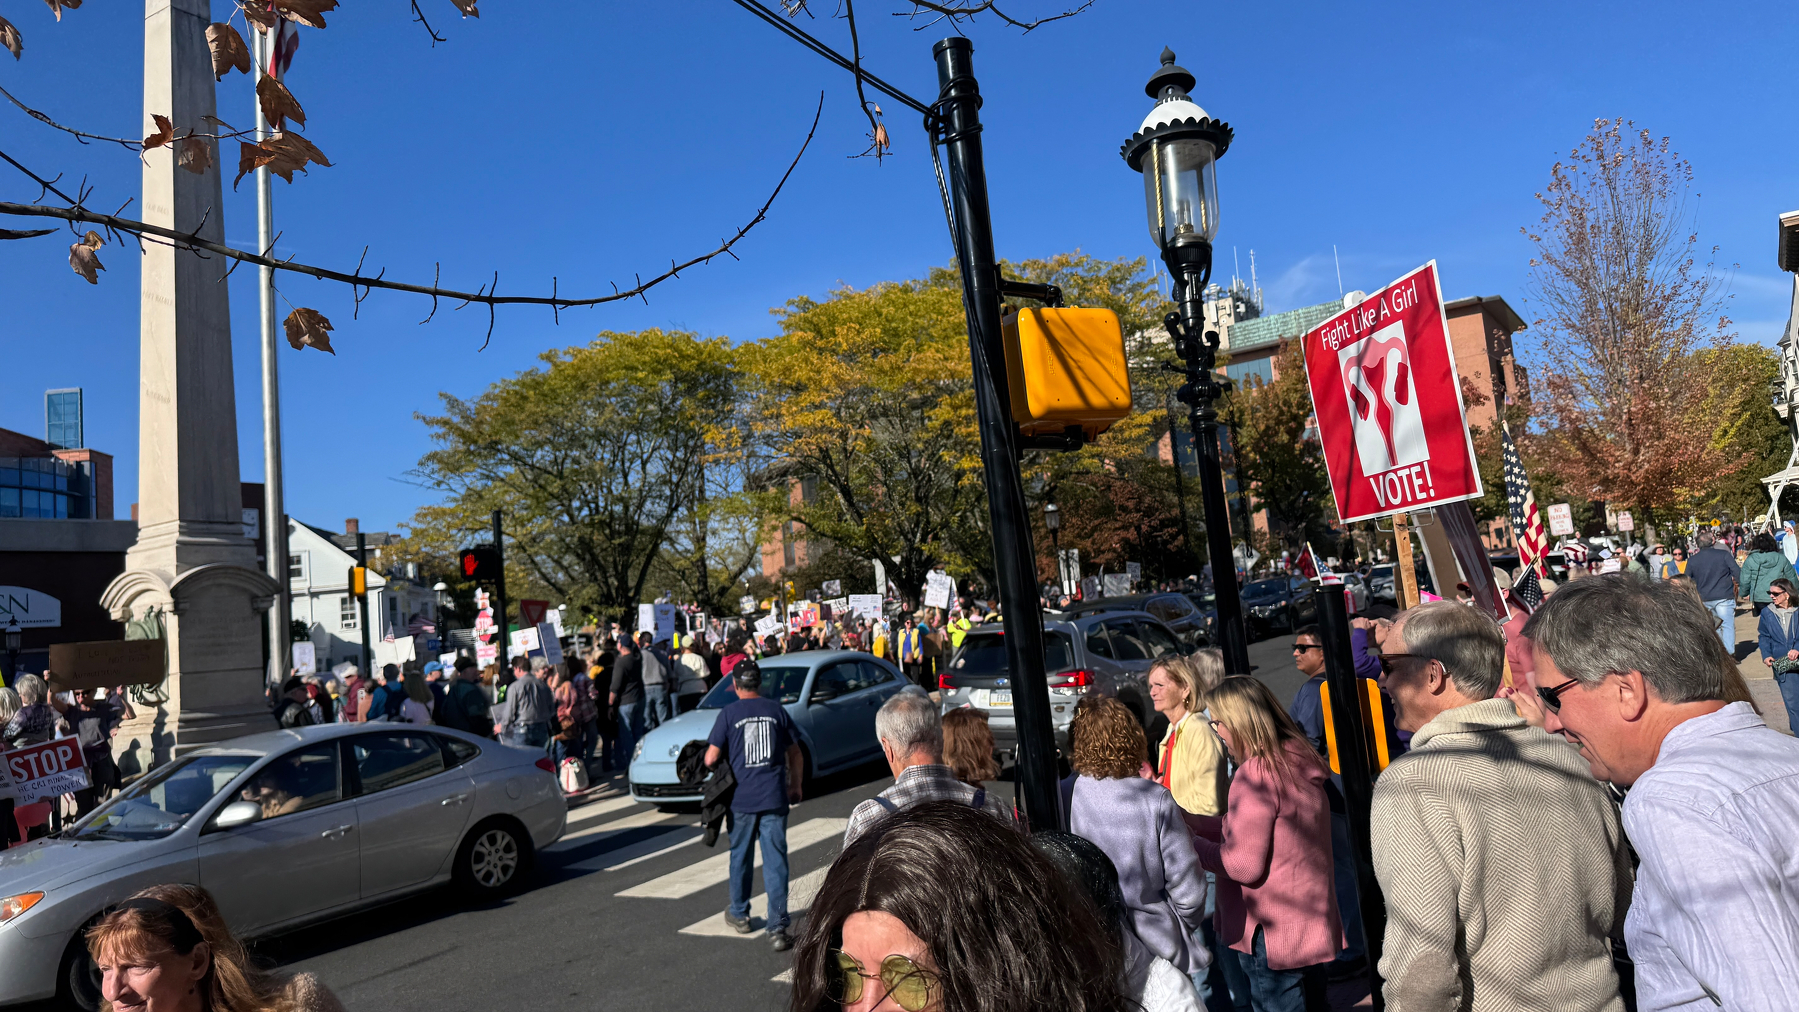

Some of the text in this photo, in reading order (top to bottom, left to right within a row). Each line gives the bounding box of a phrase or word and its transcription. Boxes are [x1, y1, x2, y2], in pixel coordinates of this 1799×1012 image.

[1321, 279, 1418, 351] Fight Like A Girl
[1369, 461, 1436, 508] VOTE!
[9, 745, 73, 783] STOP
[31, 774, 74, 790] CRIMINALS
[23, 793, 35, 802] IN
